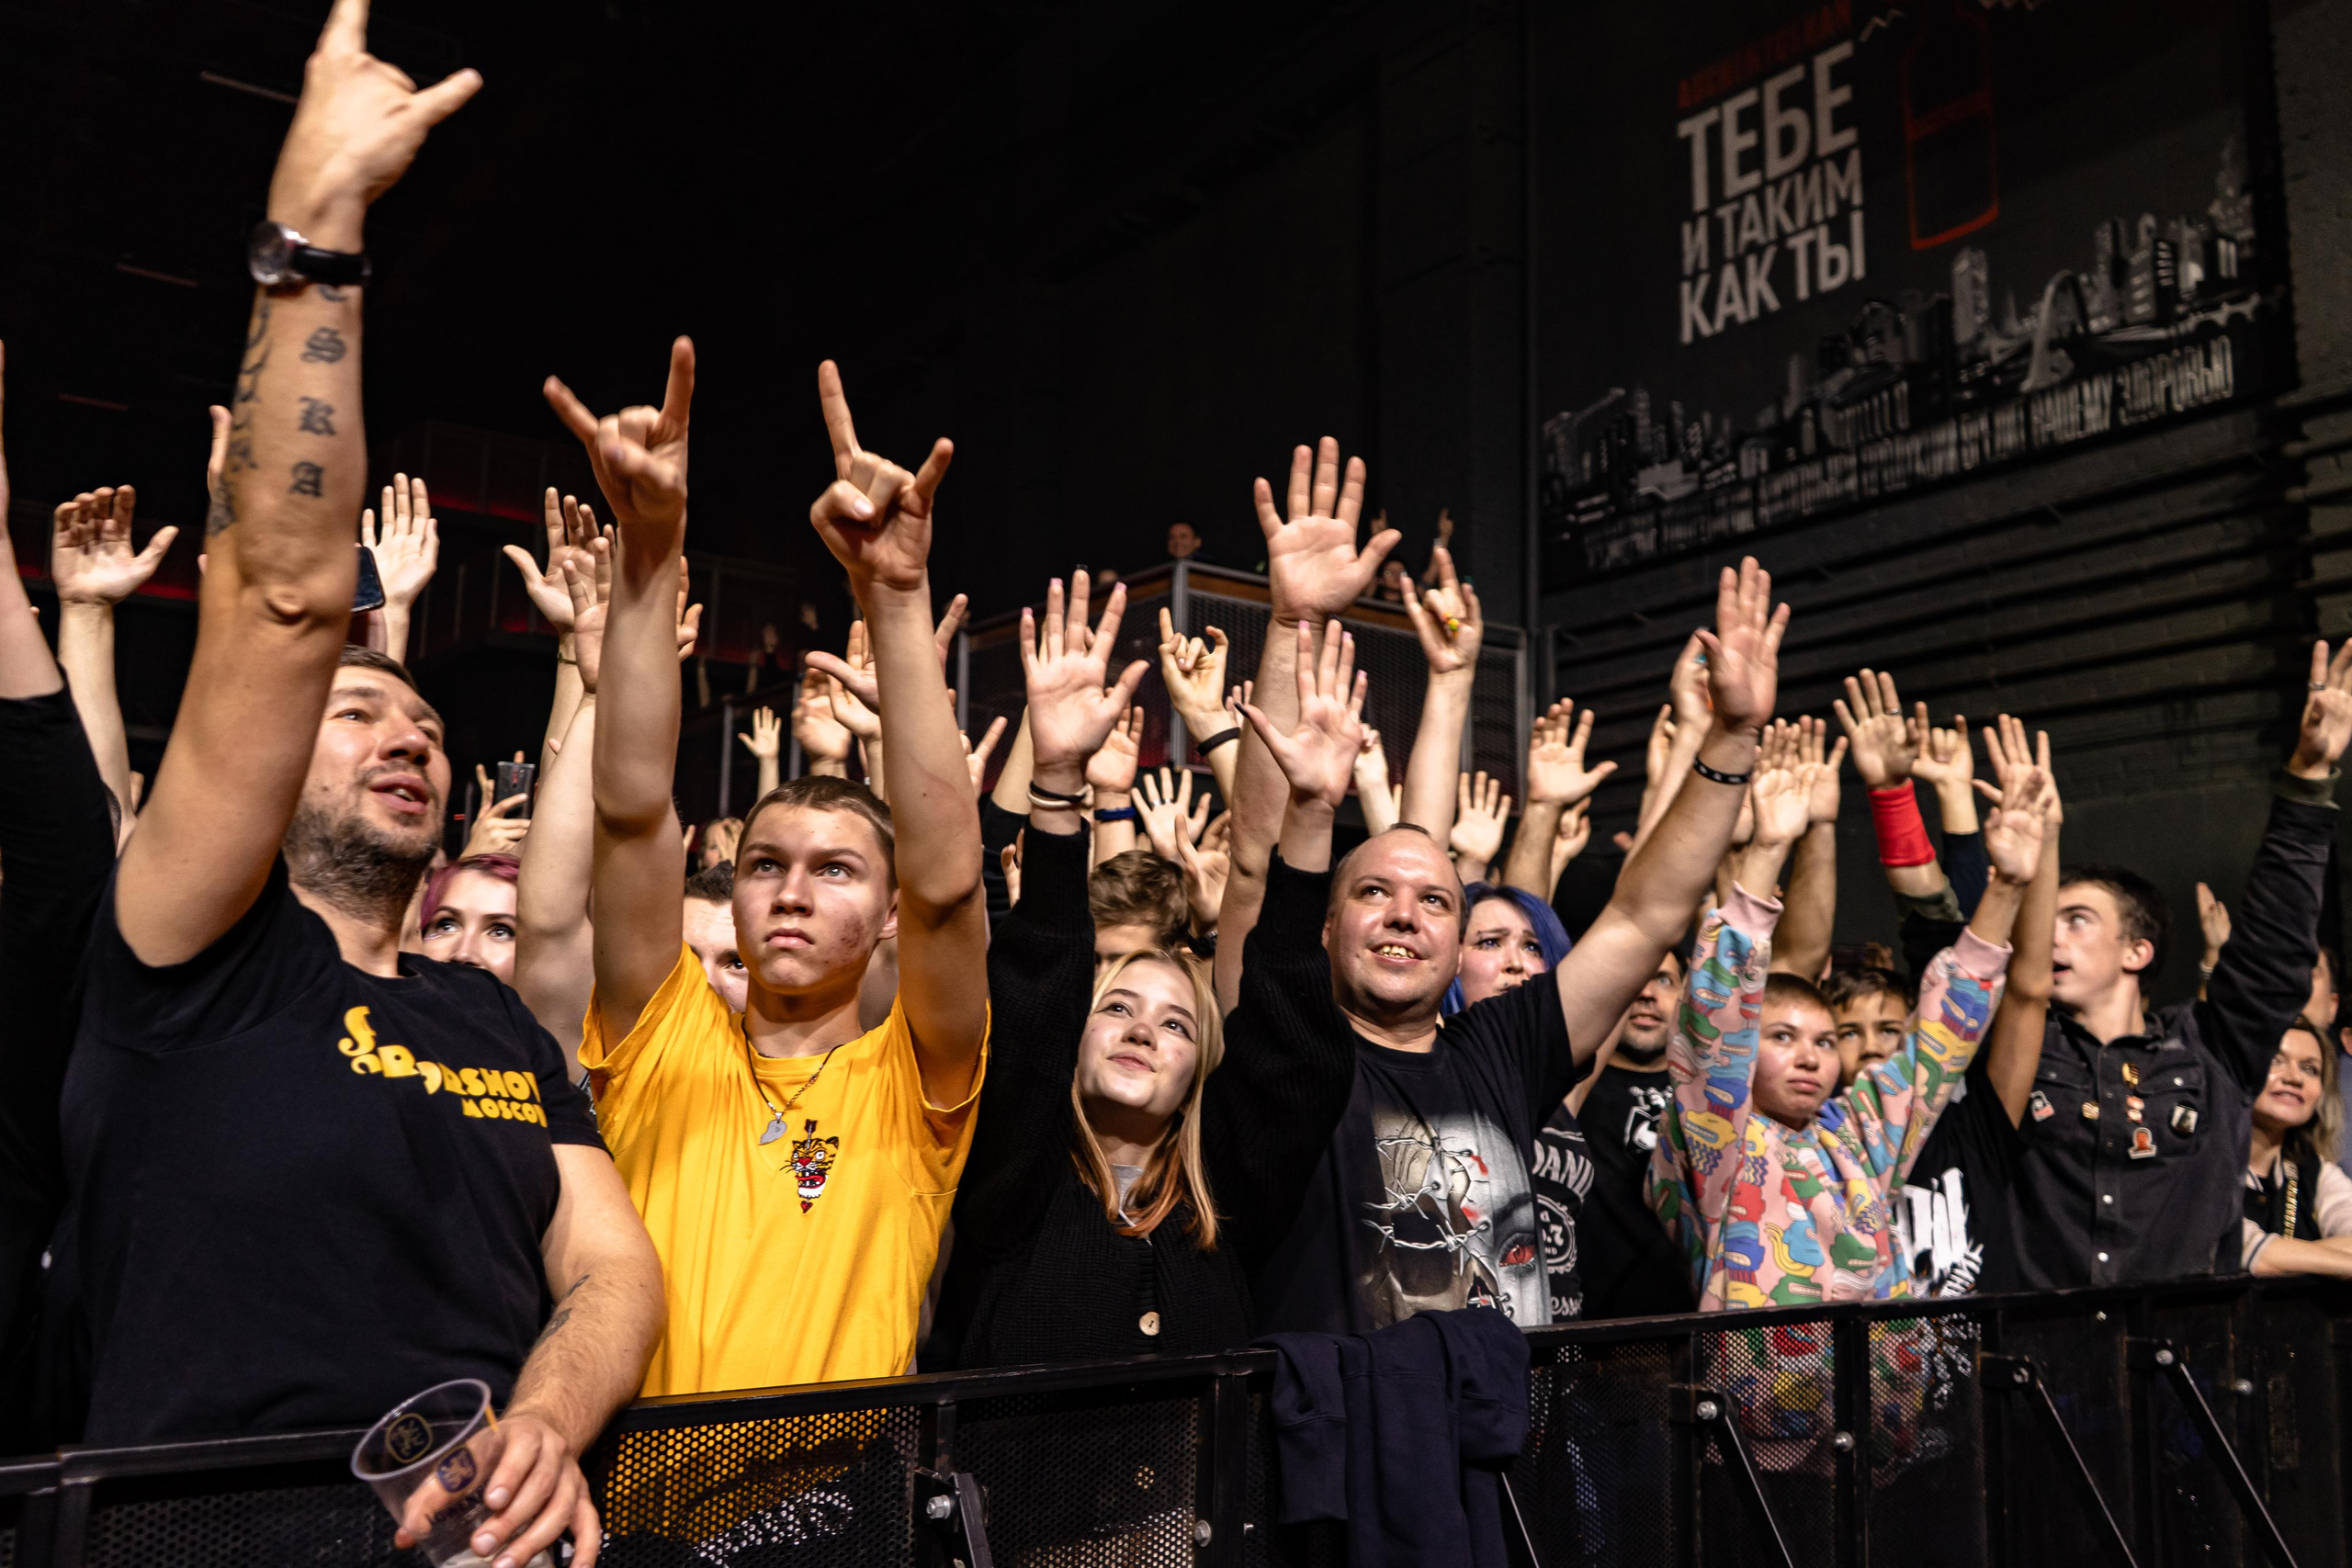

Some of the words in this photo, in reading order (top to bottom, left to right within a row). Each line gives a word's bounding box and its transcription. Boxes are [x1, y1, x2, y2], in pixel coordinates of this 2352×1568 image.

[1677, 39, 1859, 212] ТЕБЕ
[1679, 213, 1710, 276] И
[1714, 146, 1864, 261] ТАКИМ
[1679, 243, 1781, 346] КАК
[1785, 209, 1867, 302] ТЫ
